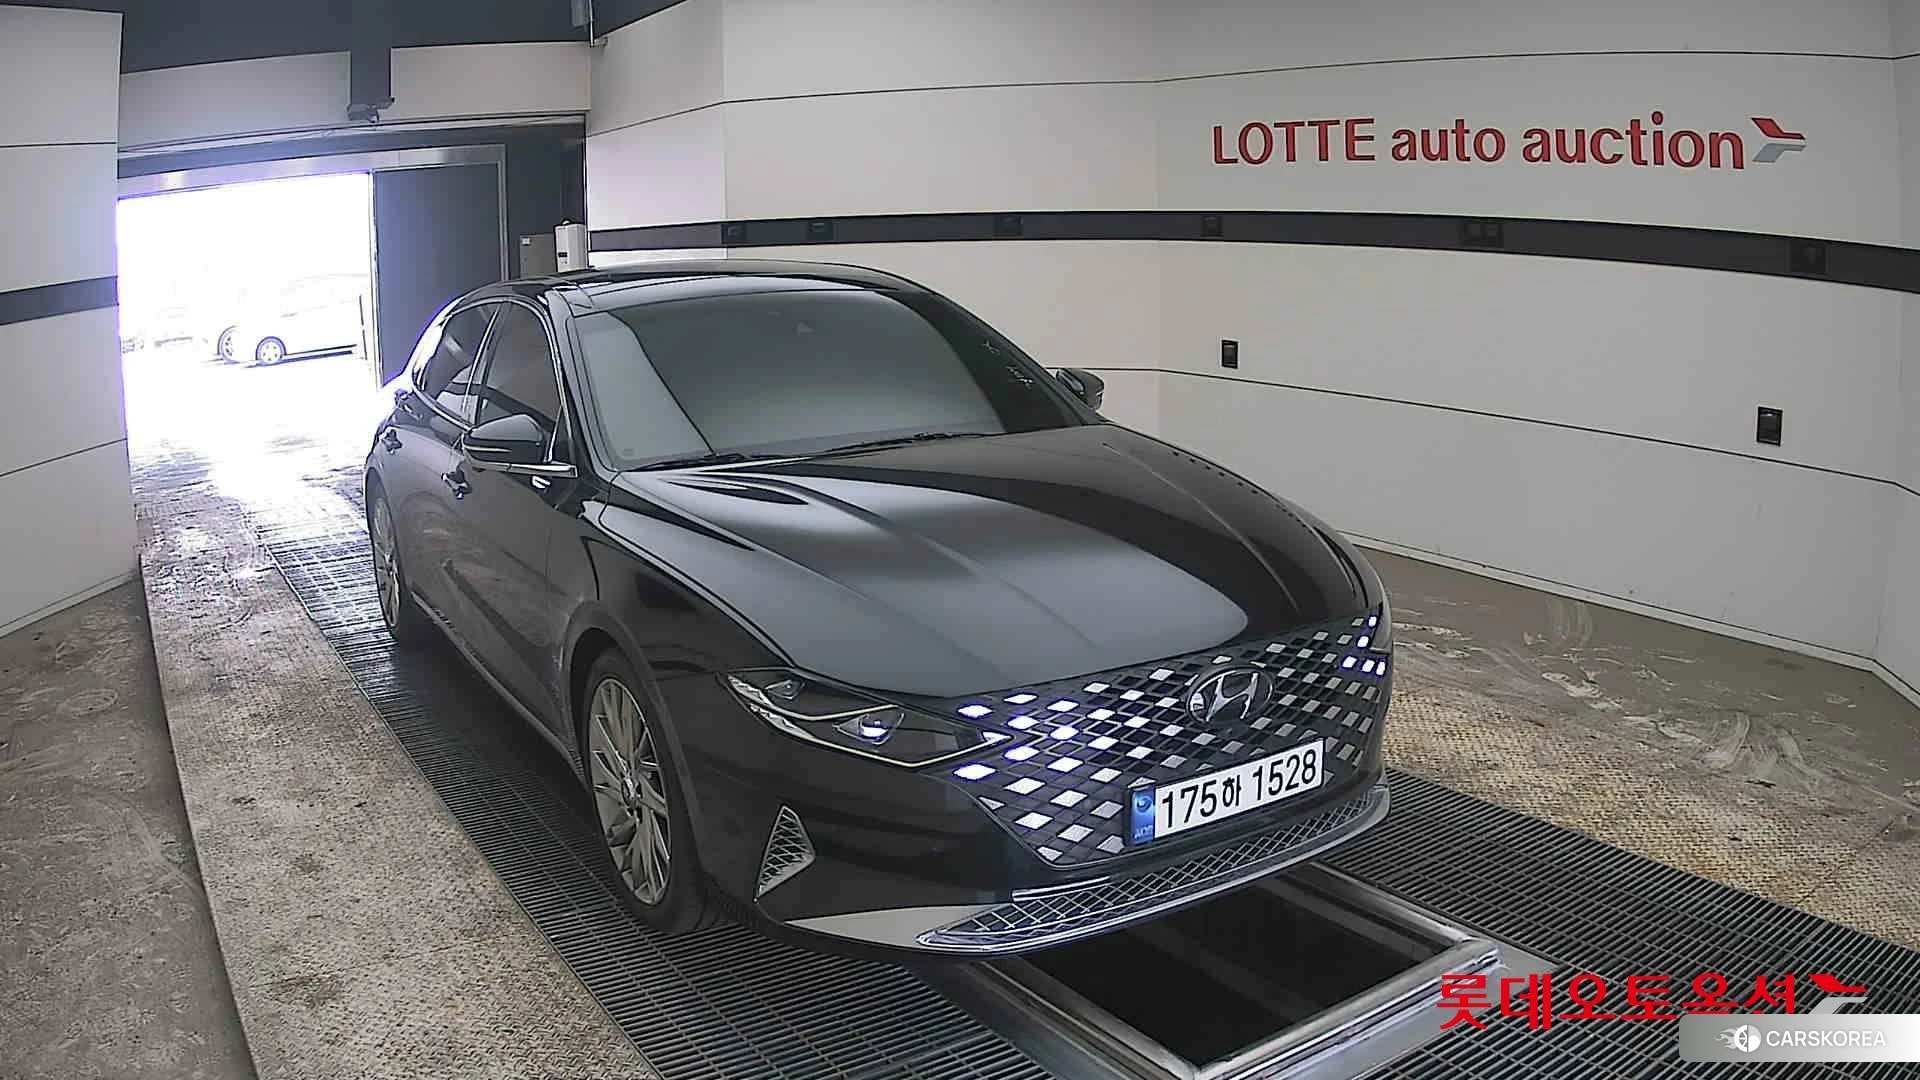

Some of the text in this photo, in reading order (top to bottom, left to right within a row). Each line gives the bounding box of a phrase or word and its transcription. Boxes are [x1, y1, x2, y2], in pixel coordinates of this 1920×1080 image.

[1212, 110, 1746, 170] LOTTE auto auction
[1161, 749, 1317, 829] 175하 1528
